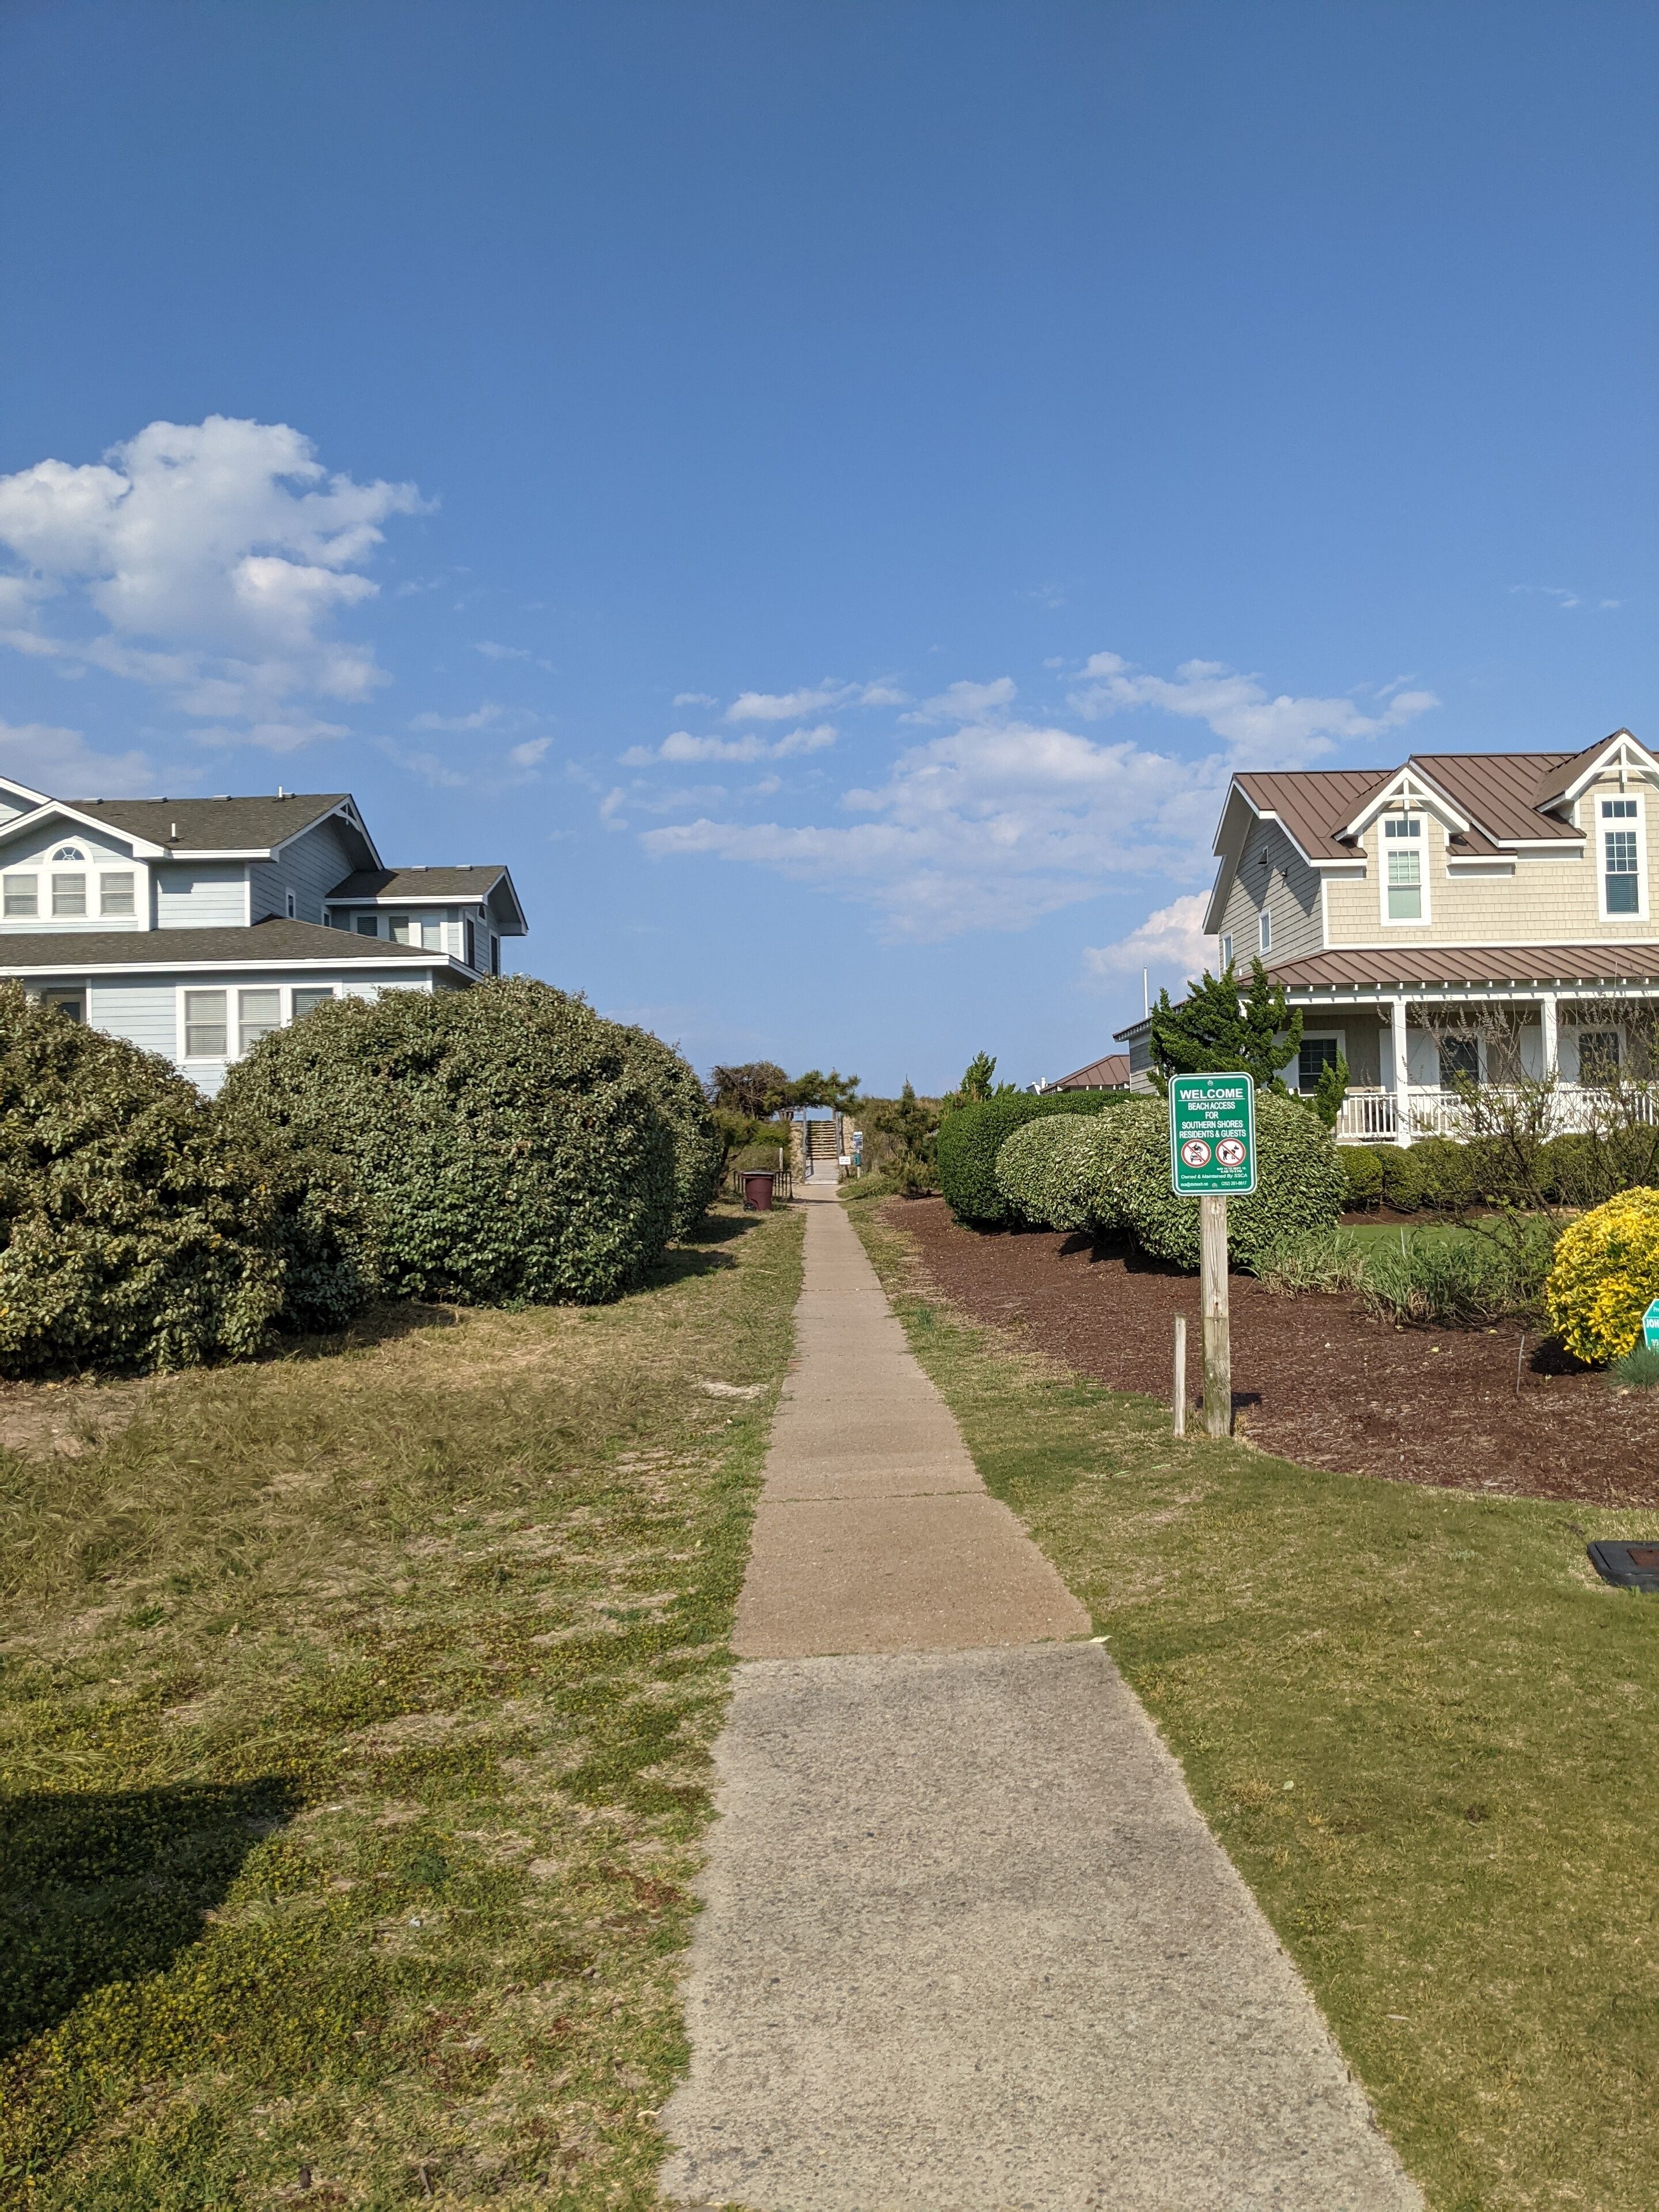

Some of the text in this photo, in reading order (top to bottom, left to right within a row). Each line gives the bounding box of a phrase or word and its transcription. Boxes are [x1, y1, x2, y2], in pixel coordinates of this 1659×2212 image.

[1180, 1088, 1243, 1099] WELCOME
[1188, 1101, 1235, 1110] BEACH ACCESS
[1181, 1120, 1243, 1129] SOUTHERN SHORES
[1179, 1130, 1214, 1138] RESIDENTS
[1221, 1129, 1246, 1137] GUESTS
[1646, 1319, 1659, 1328] JOH
